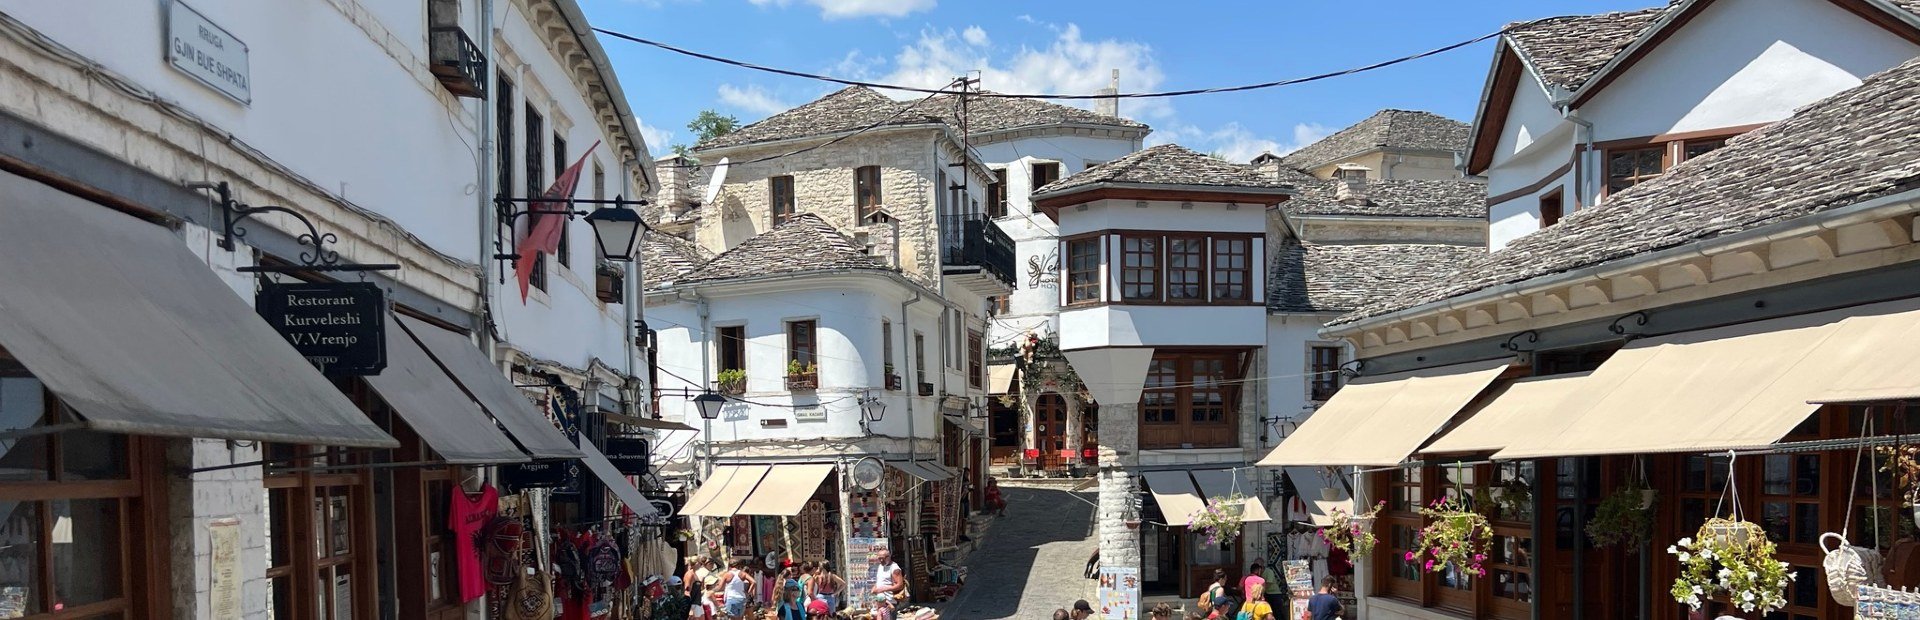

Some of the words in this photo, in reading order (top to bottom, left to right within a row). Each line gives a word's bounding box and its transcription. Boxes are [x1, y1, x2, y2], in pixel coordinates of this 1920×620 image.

[198, 25, 224, 51] RRUGA
[174, 37, 195, 62] GJIN
[216, 61, 248, 91] SHPATA
[287, 294, 355, 306] Restorant
[284, 312, 361, 326] Kurveleshi
[290, 332, 358, 348] V.Vrenjo
[520, 463, 549, 471] Argjiro
